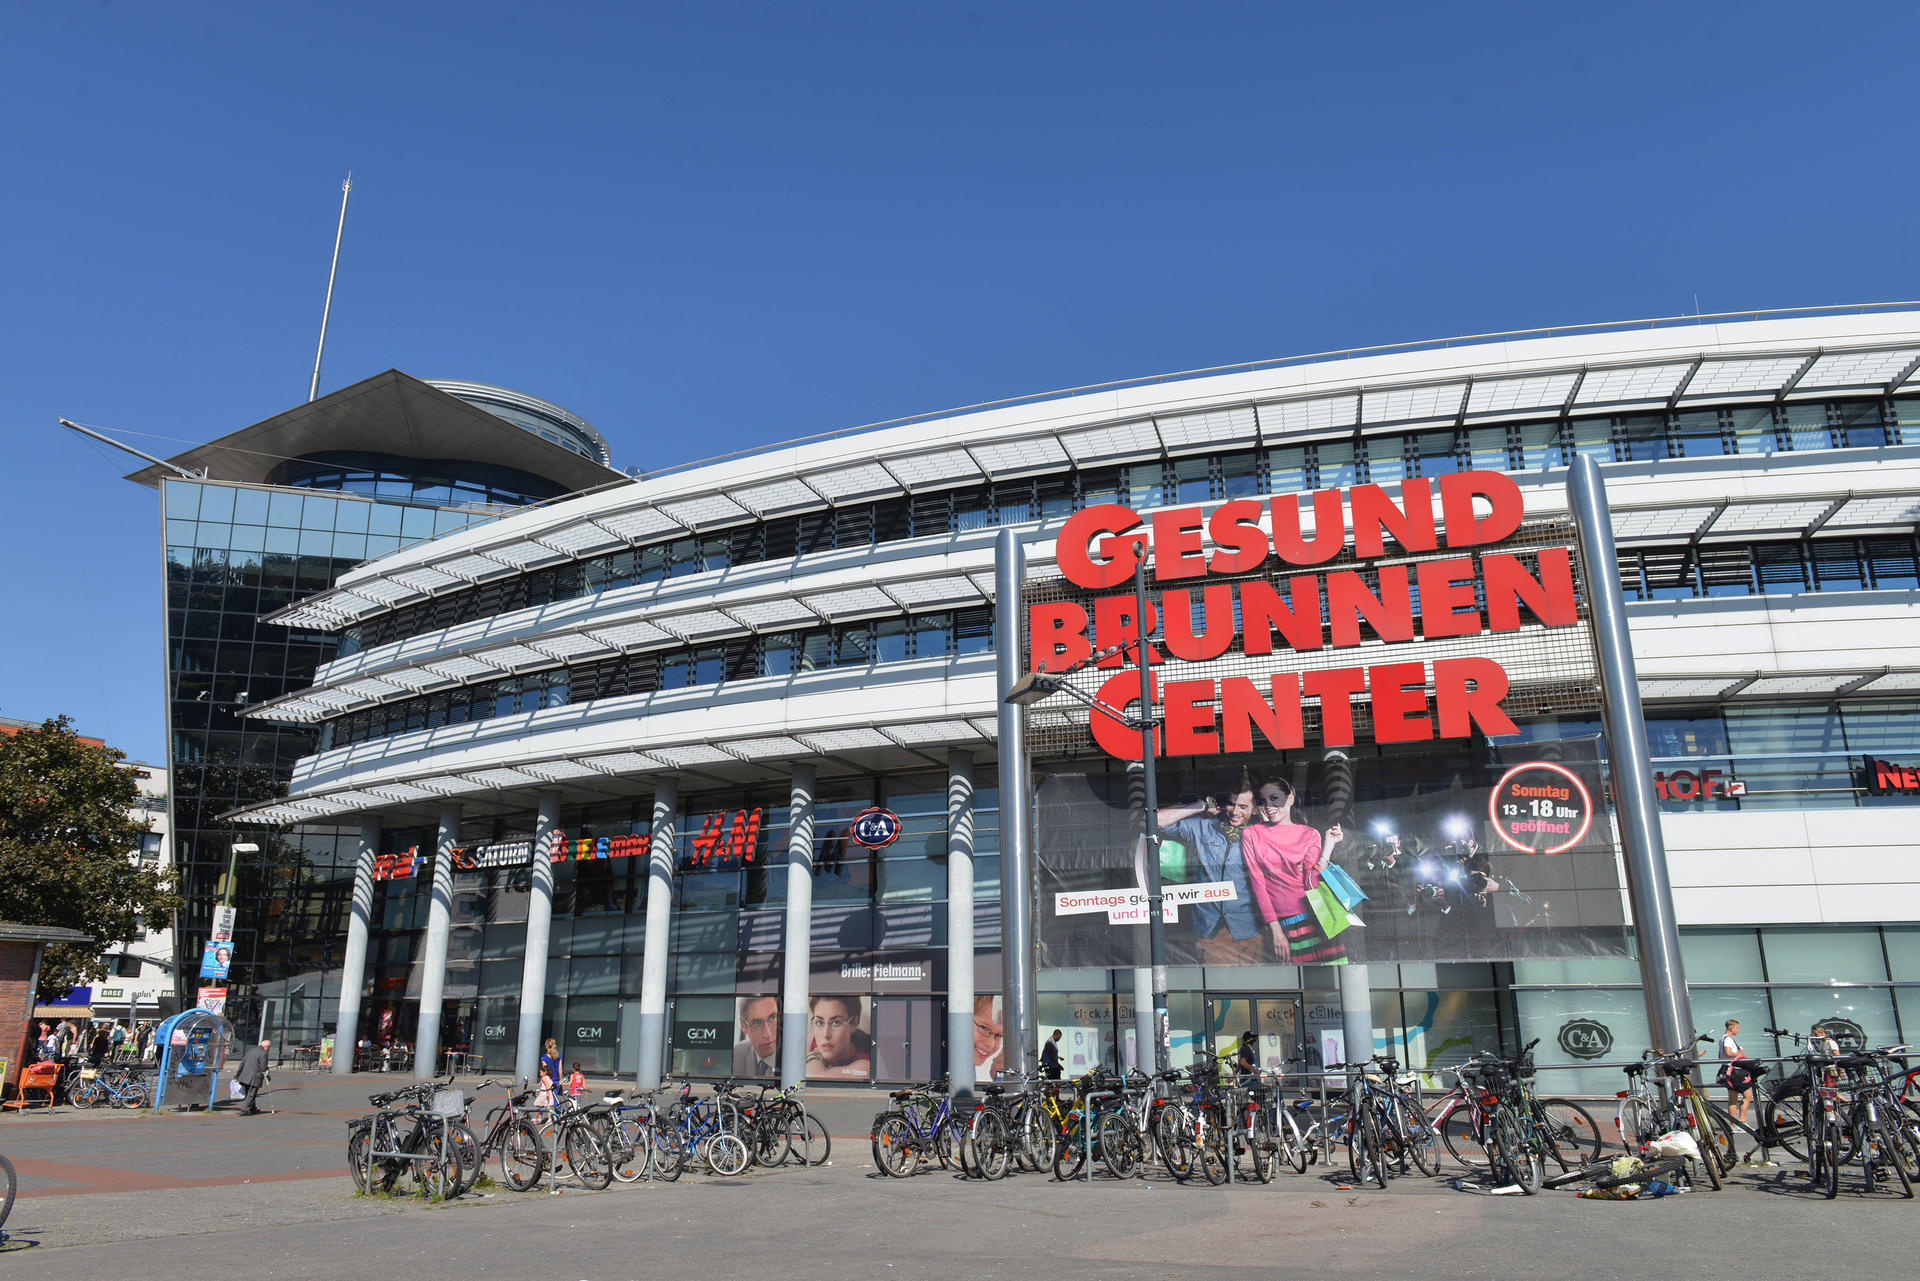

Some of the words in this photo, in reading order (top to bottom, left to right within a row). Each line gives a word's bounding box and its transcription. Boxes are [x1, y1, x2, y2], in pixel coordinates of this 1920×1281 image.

[1056, 470, 1524, 589] GESUND
[1030, 547, 1578, 674] BRUNNEN
[1090, 656, 1522, 761] CENTER
[1511, 783, 1570, 800] Sonntag
[1502, 804, 1518, 816] 13
[1529, 799, 1553, 817] 18
[1556, 806, 1579, 818] Uhr
[691, 807, 763, 866] H&M
[860, 819, 891, 837] C&A
[1511, 820, 1570, 834] geöffnet
[476, 841, 530, 869] SATURN
[1059, 894, 1126, 908] Sonntags
[1130, 891, 1174, 906] gen
[1178, 889, 1200, 900] wir
[1204, 886, 1231, 899] aus
[1112, 908, 1138, 920] und
[1143, 907, 1174, 919] rn.
[841, 962, 871, 978] Brille:
[874, 962, 926, 979] Fielmann.
[1568, 1029, 1605, 1048] C&A
